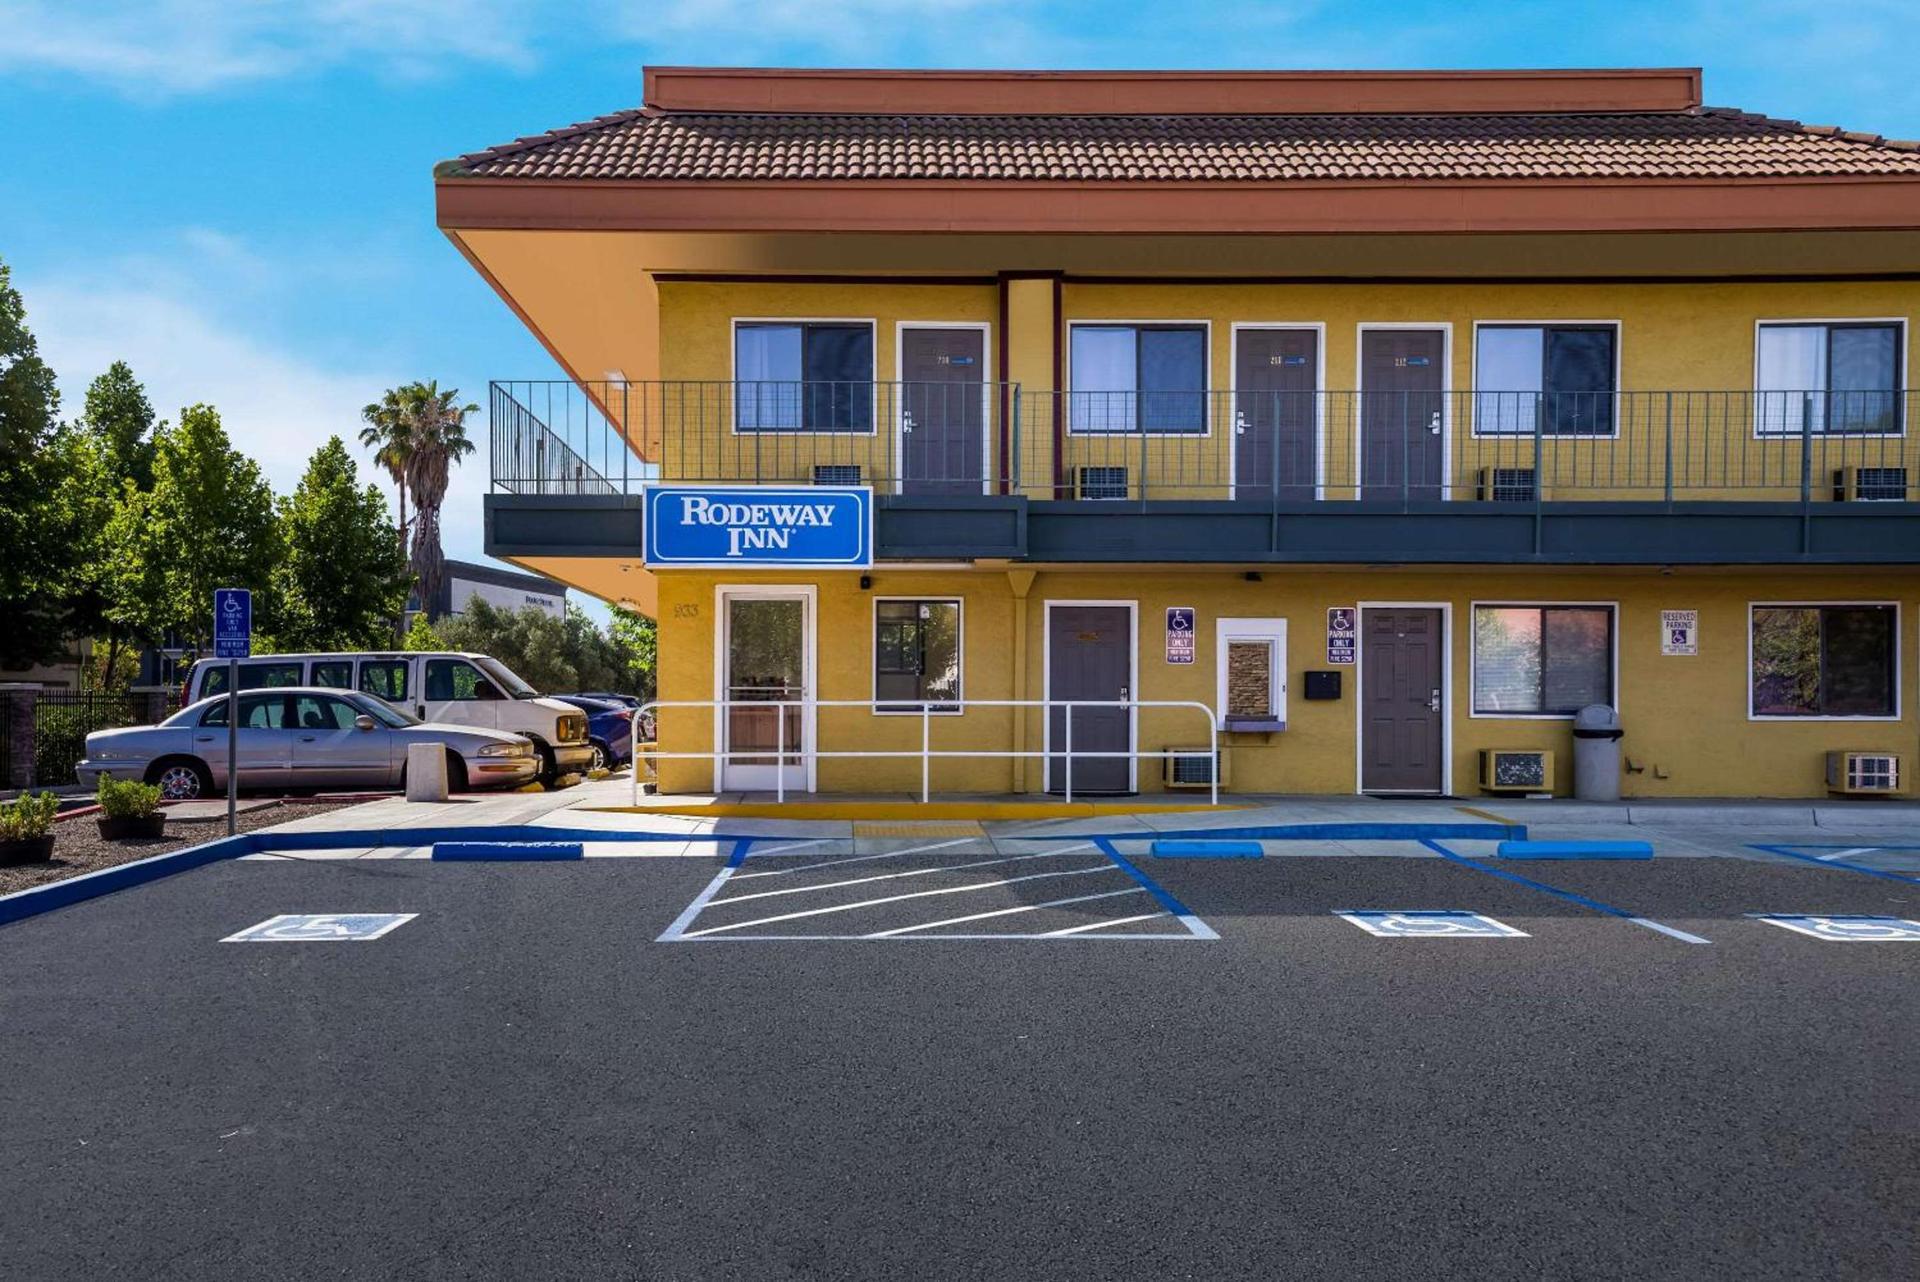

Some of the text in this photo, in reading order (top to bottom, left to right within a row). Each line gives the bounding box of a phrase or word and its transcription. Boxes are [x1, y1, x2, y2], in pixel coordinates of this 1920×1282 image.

[680, 496, 836, 526] RODEWAY
[726, 527, 792, 556] INN
[1663, 612, 1694, 620] RESERVED
[1666, 621, 1692, 629] PARKING
[1168, 630, 1192, 638] PARKING
[1329, 630, 1354, 638] PARKING
[1171, 639, 1189, 647] ONLY
[1333, 639, 1350, 647] ONLY
